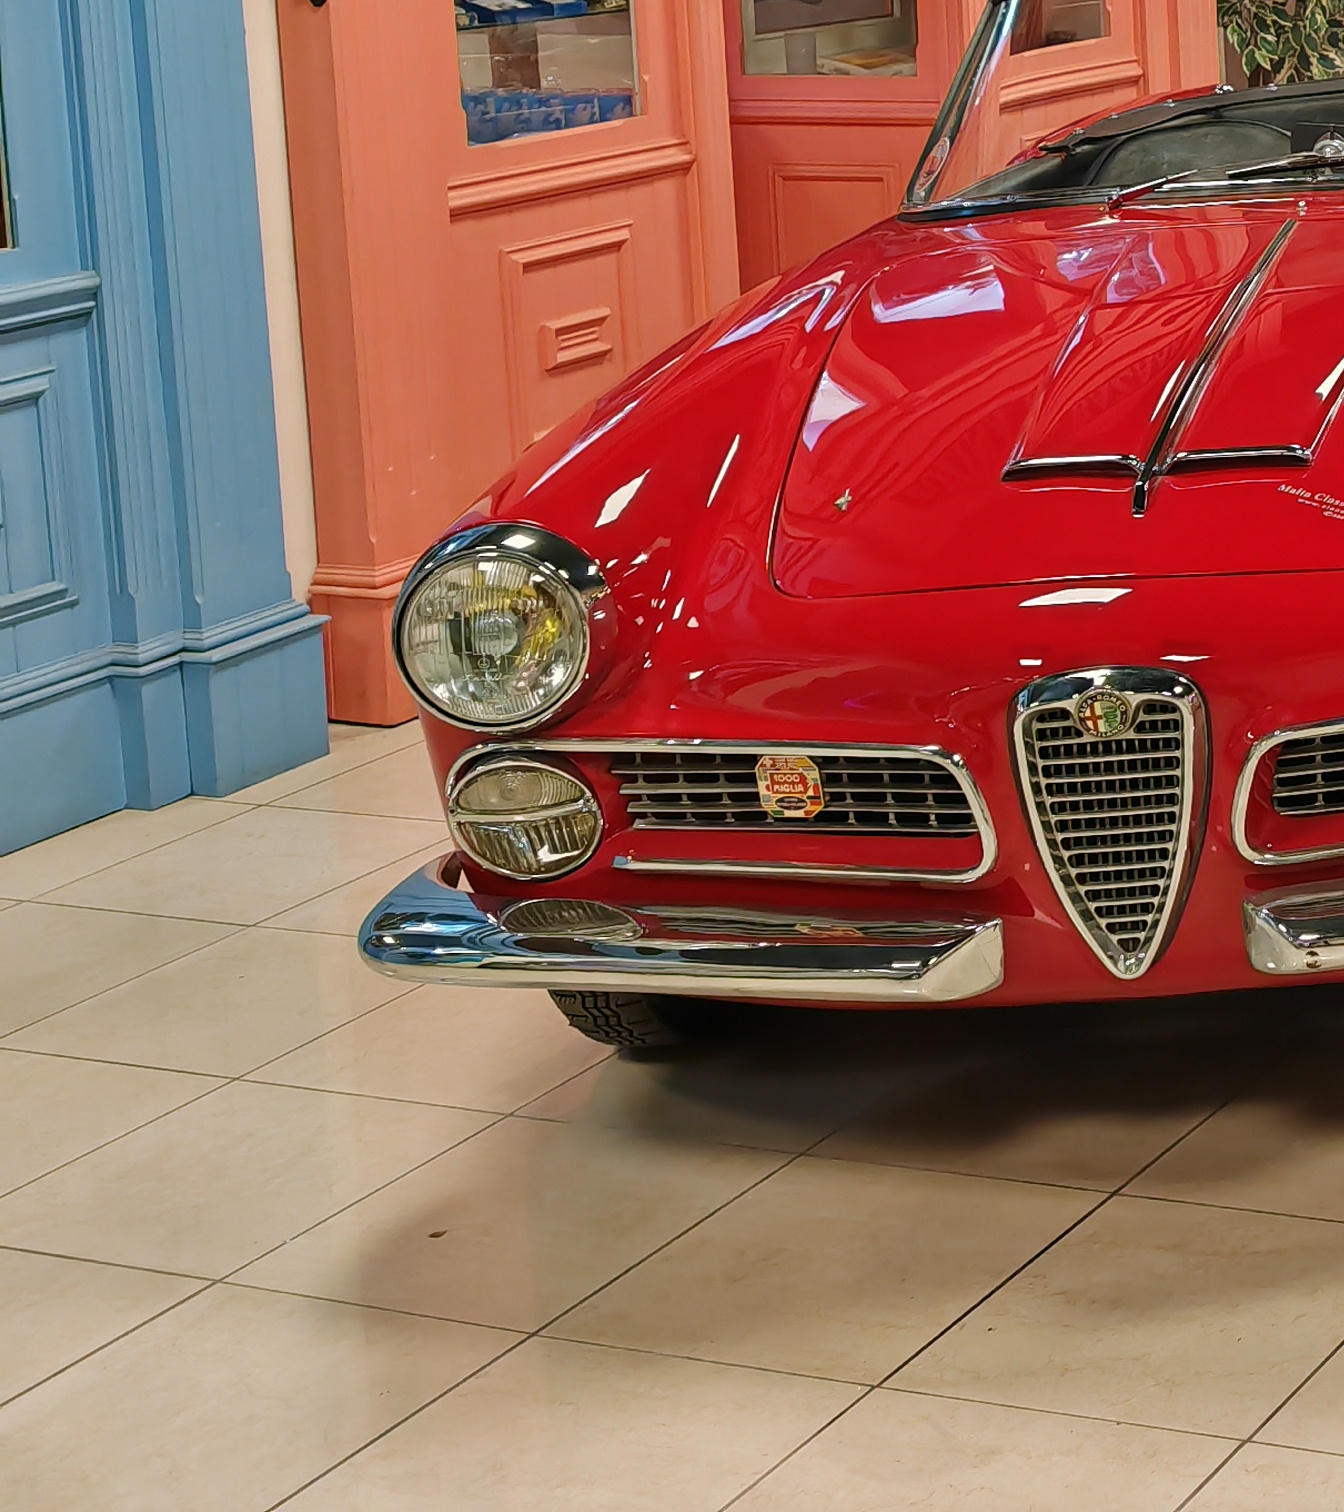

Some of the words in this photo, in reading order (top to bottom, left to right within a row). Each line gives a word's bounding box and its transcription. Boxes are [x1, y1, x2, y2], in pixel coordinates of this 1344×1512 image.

[1277, 483, 1312, 499] Malta
[1088, 724, 1124, 738] MILANO
[773, 773, 801, 783] 1000
[772, 783, 805, 793] MIGLIA
